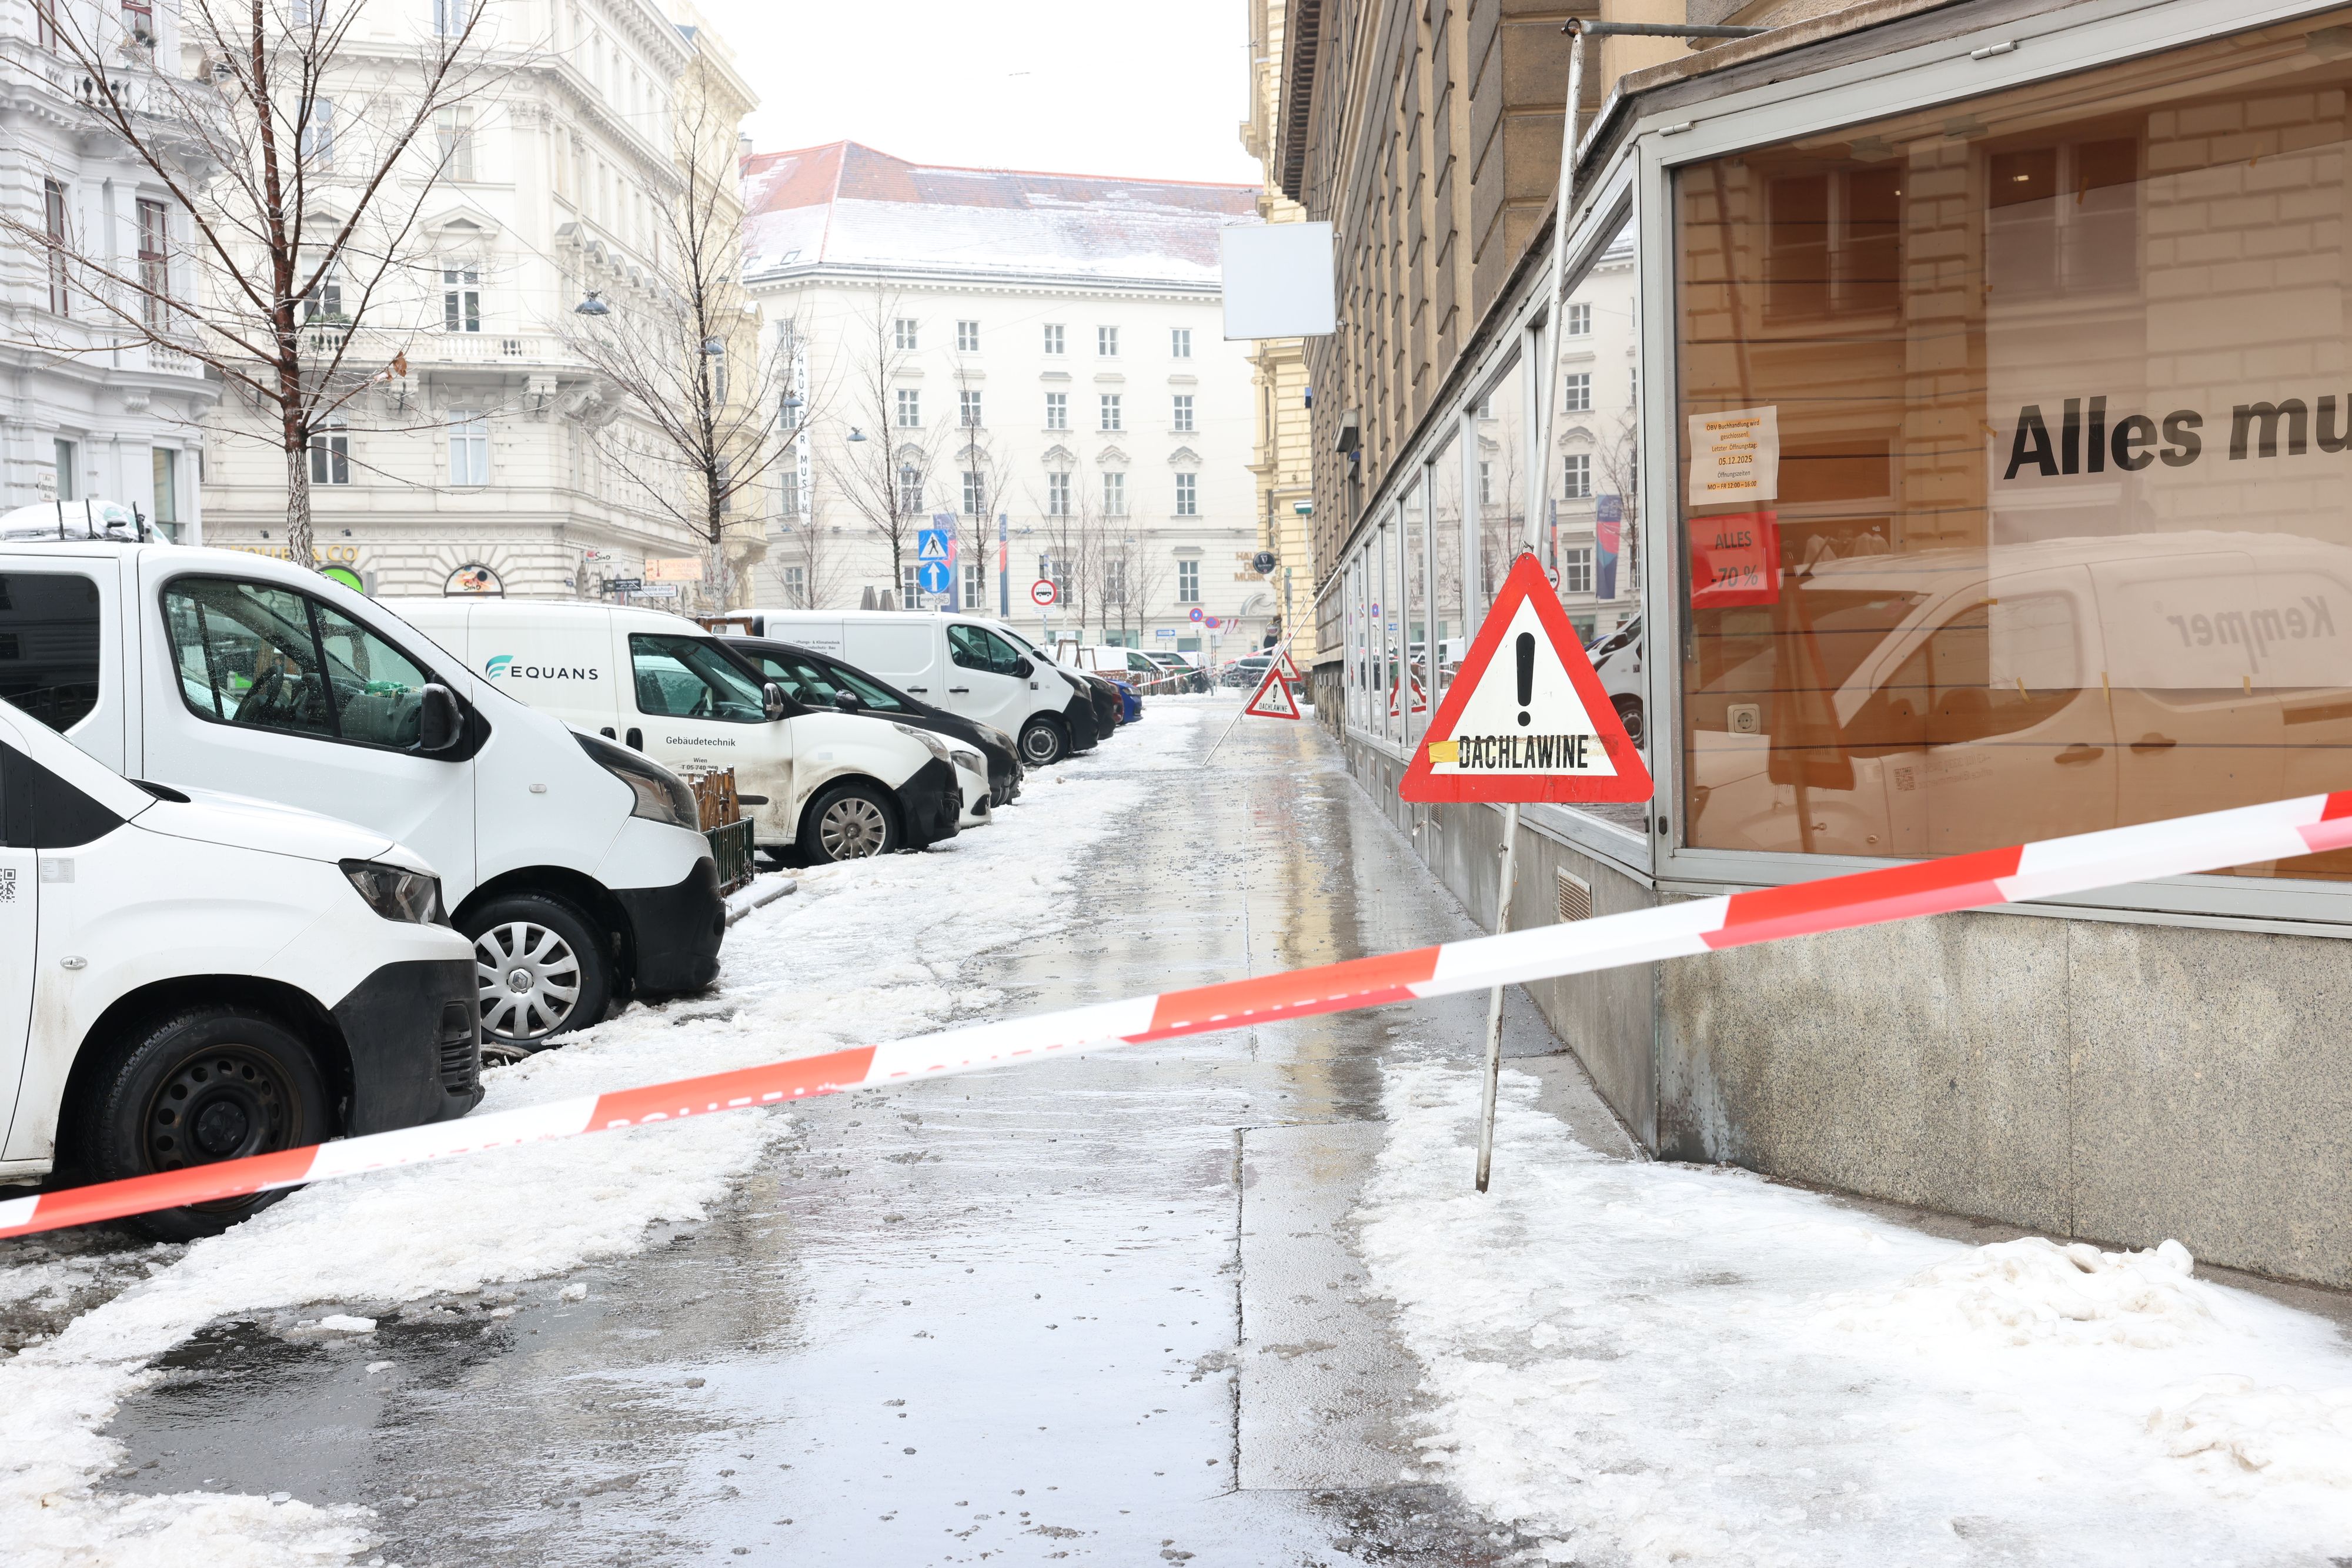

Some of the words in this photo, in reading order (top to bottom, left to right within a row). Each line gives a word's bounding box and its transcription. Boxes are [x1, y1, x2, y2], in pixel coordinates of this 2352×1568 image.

[1706, 423, 1718, 431] ÖBV
[1718, 422, 1749, 430] Buchhandlung
[1720, 431, 1749, 441] geschlossen!
[2003, 395, 2204, 480] Alles
[1719, 455, 1752, 466] 05.12.2025
[1718, 470, 1750, 479] Öffnungszeiten
[1715, 531, 1752, 549] ALLES
[327, 545, 358, 561] CO
[1743, 564, 1759, 587] %
[511, 666, 598, 680] EQUANS
[1259, 702, 1288, 713] DACHLAWINE
[666, 736, 736, 747] Gebäudetechnik
[1459, 735, 1588, 768] DACHLAWINE
